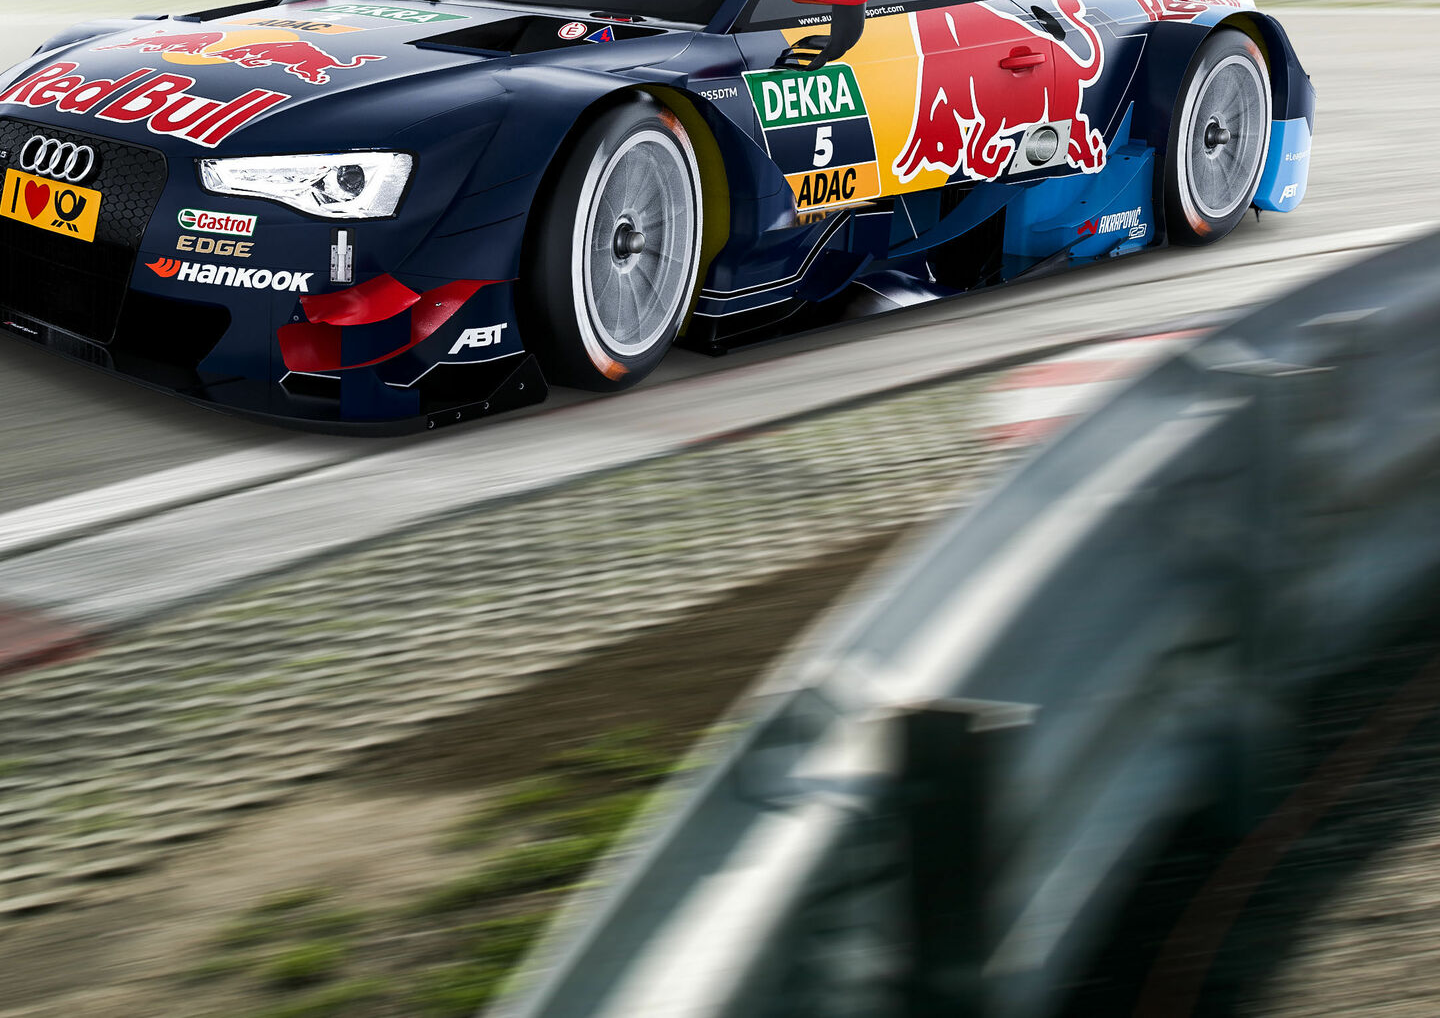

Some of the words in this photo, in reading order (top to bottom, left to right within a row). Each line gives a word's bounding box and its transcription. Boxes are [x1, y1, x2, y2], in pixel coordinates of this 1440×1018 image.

[247, 19, 333, 31] ADAC
[323, 5, 437, 24] DEKRA
[697, 86, 738, 101] RS5DTM
[761, 72, 856, 122] DEKRA
[94, 72, 292, 149] Bull
[812, 125, 834, 168] 5
[797, 167, 857, 208] ADAC
[197, 213, 252, 233] Castrol
[176, 235, 255, 258] EDGE
[447, 322, 508, 355] ABT
